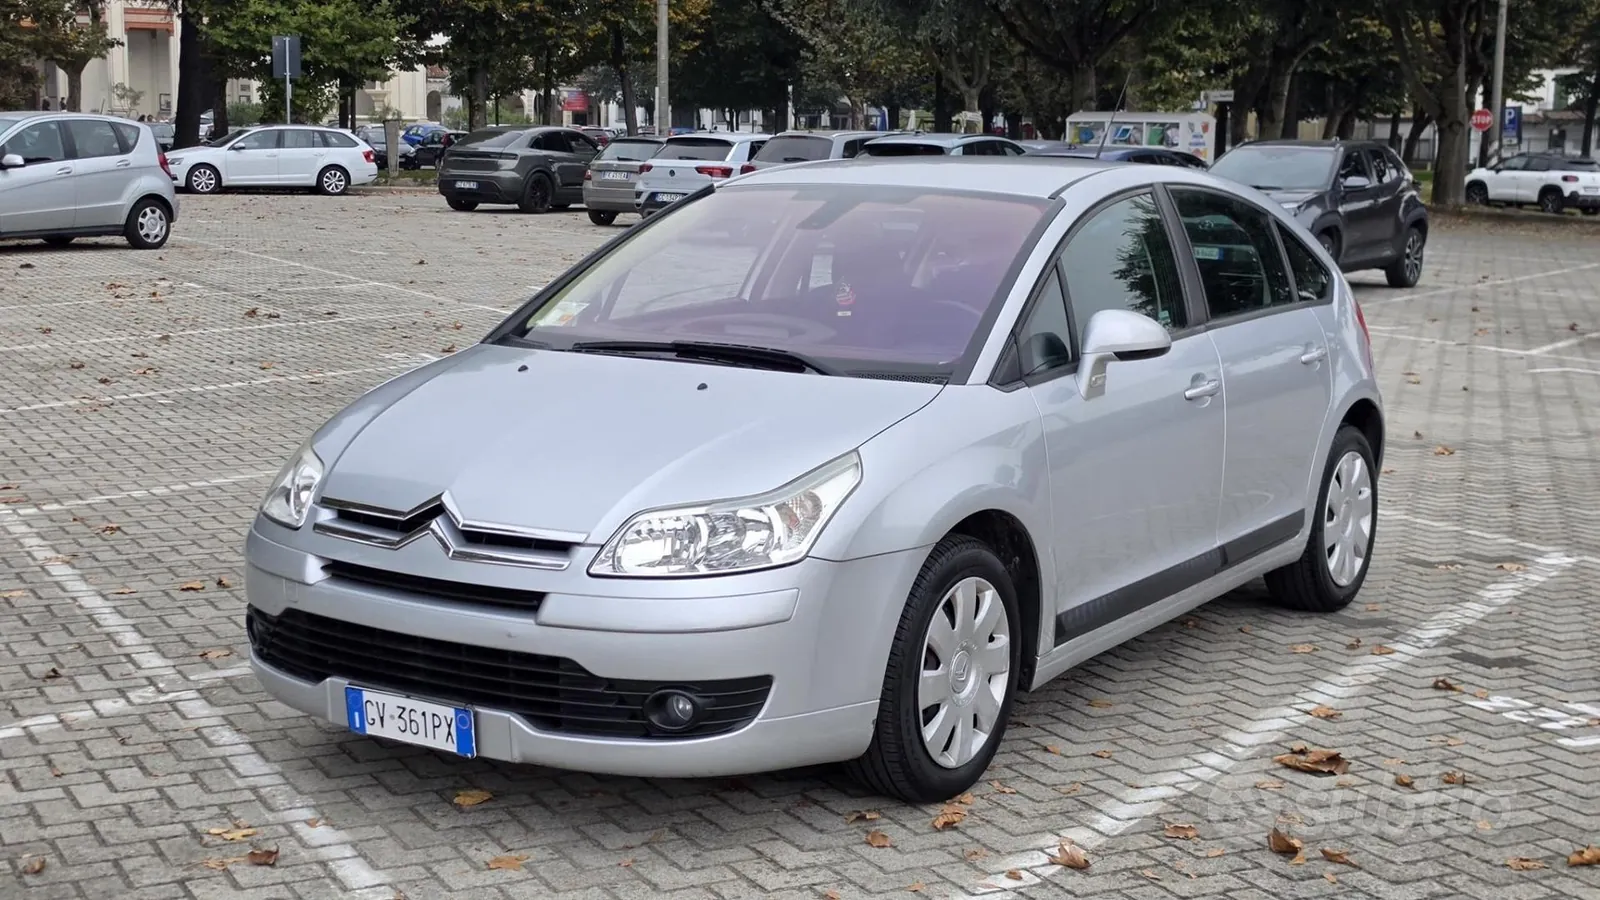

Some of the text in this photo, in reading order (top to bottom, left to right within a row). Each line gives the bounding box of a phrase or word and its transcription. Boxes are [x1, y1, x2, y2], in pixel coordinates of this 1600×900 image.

[1472, 115, 1491, 124] STOP
[1505, 108, 1515, 125] P
[364, 700, 455, 745] GV 361PX
